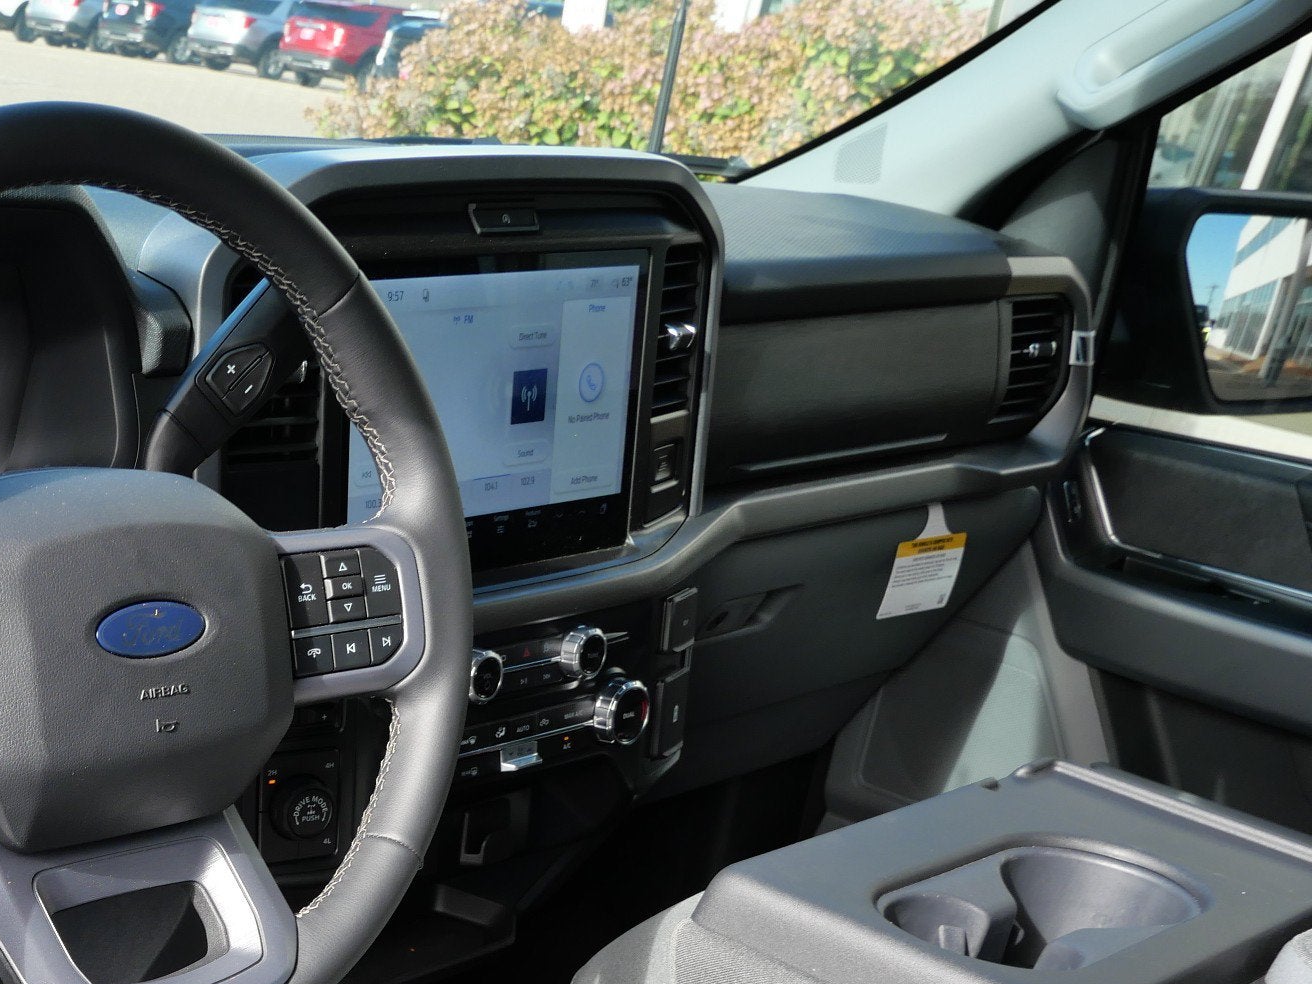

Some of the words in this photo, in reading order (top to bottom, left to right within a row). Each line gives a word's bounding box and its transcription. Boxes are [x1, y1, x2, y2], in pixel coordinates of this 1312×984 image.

[464, 315, 474, 324] FM
[341, 582, 352, 590] OK
[372, 585, 391, 593] MENU
[298, 593, 317, 602] BACK
[140, 684, 189, 700] AIRBAG
[516, 725, 529, 733] AUTO
[325, 761, 335, 769] 4H
[267, 769, 278, 777] 2H
[293, 797, 310, 817] DRIVE
[311, 796, 328, 812] MODE
[301, 814, 320, 823] PUSH
